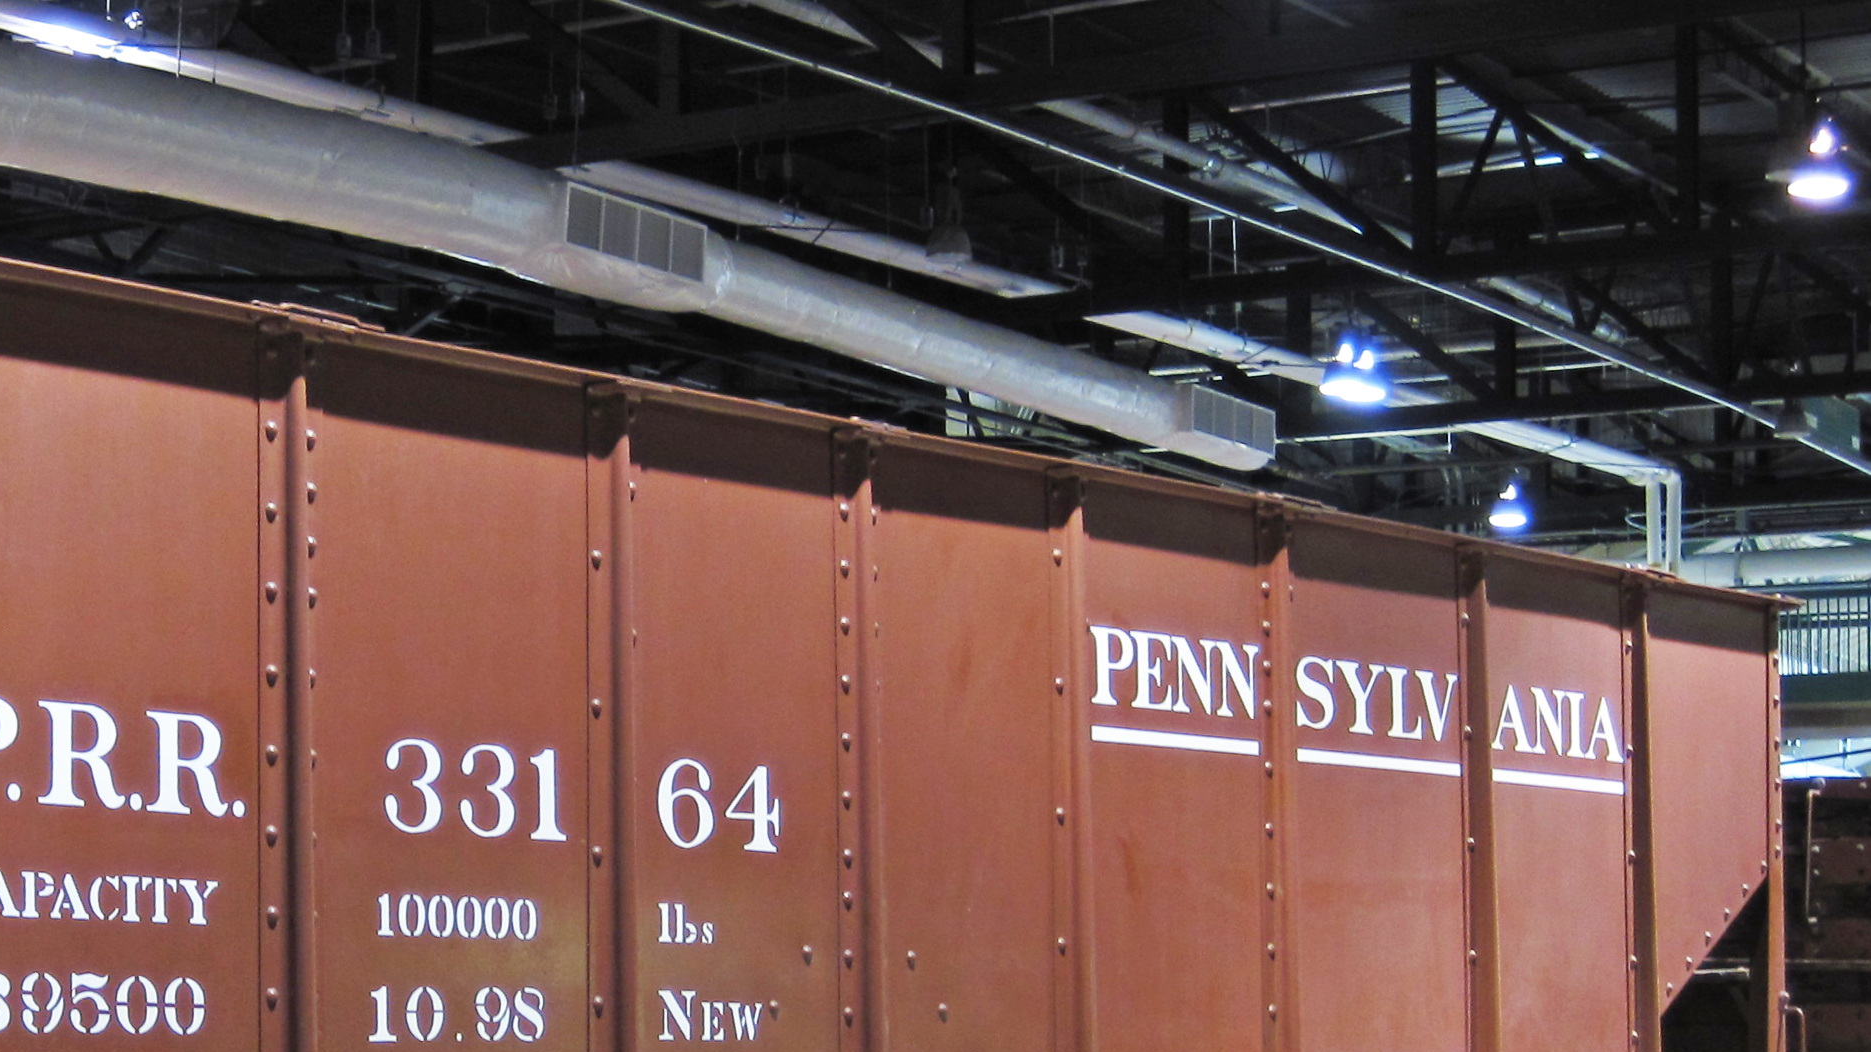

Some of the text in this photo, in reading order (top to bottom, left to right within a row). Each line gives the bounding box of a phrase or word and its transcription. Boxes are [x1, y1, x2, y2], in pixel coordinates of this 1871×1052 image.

[1090, 624, 1625, 764] PENN SYLV ANIA
[384, 737, 568, 842] 331
[656, 757, 781, 853] 64
[376, 892, 538, 940] 100000
[657, 902, 715, 944] lbs
[367, 985, 546, 1043] 10.98
